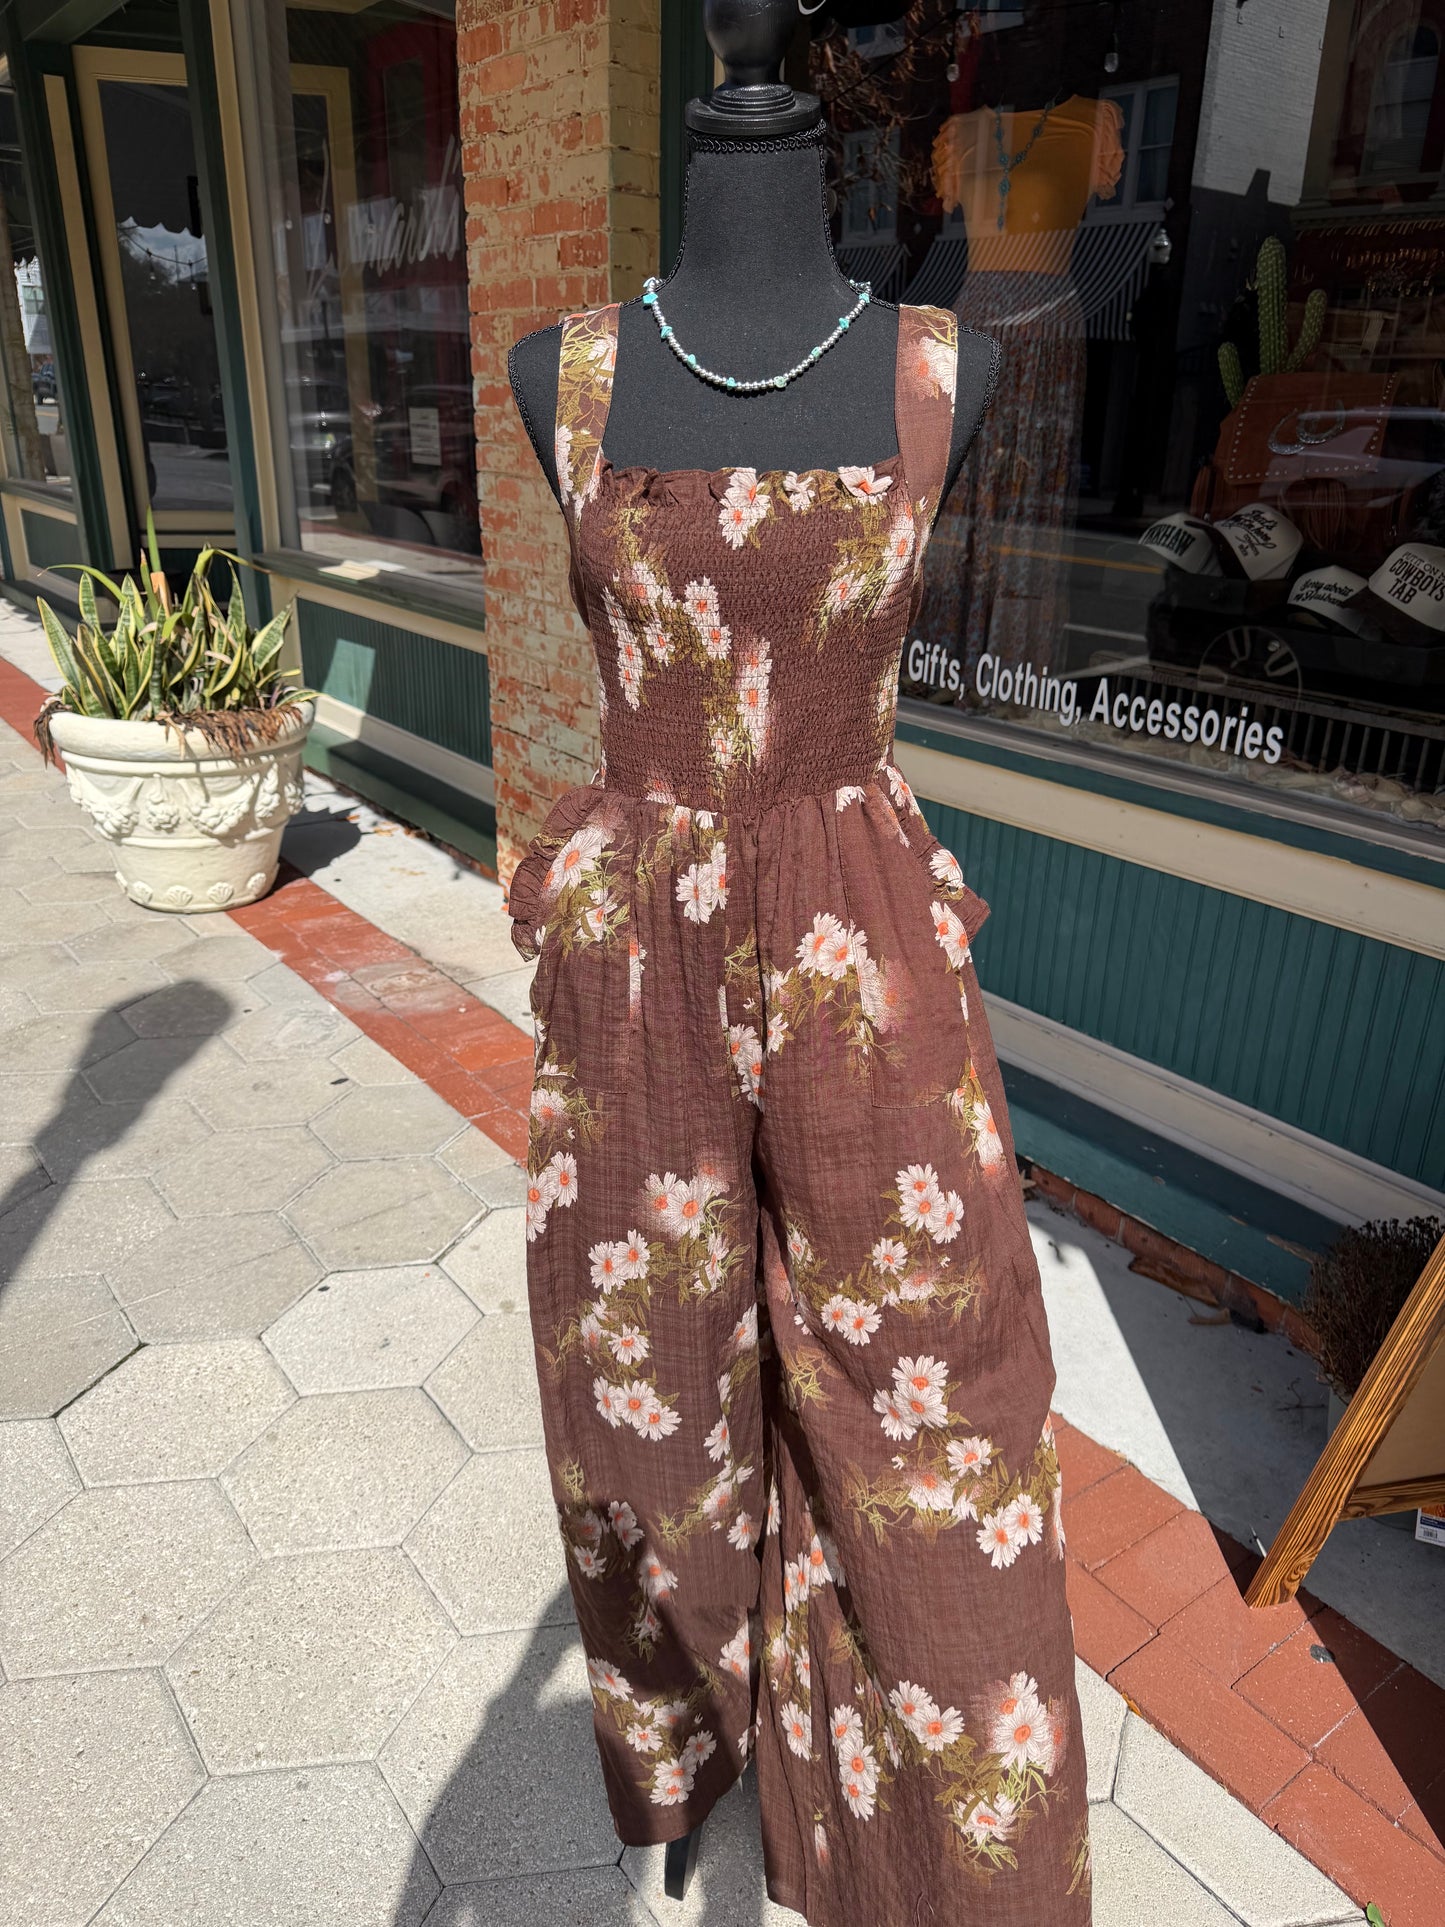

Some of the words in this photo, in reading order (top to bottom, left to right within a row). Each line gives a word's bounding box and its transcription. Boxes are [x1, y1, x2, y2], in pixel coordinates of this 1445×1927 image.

[1389, 558, 1445, 602] COWBOYS
[1424, 563, 1440, 575] ON
[1388, 577, 1418, 604] TAB
[907, 639, 966, 700] Gifts,
[975, 653, 1082, 728] Clothing,
[1089, 677, 1285, 765] Accessories
